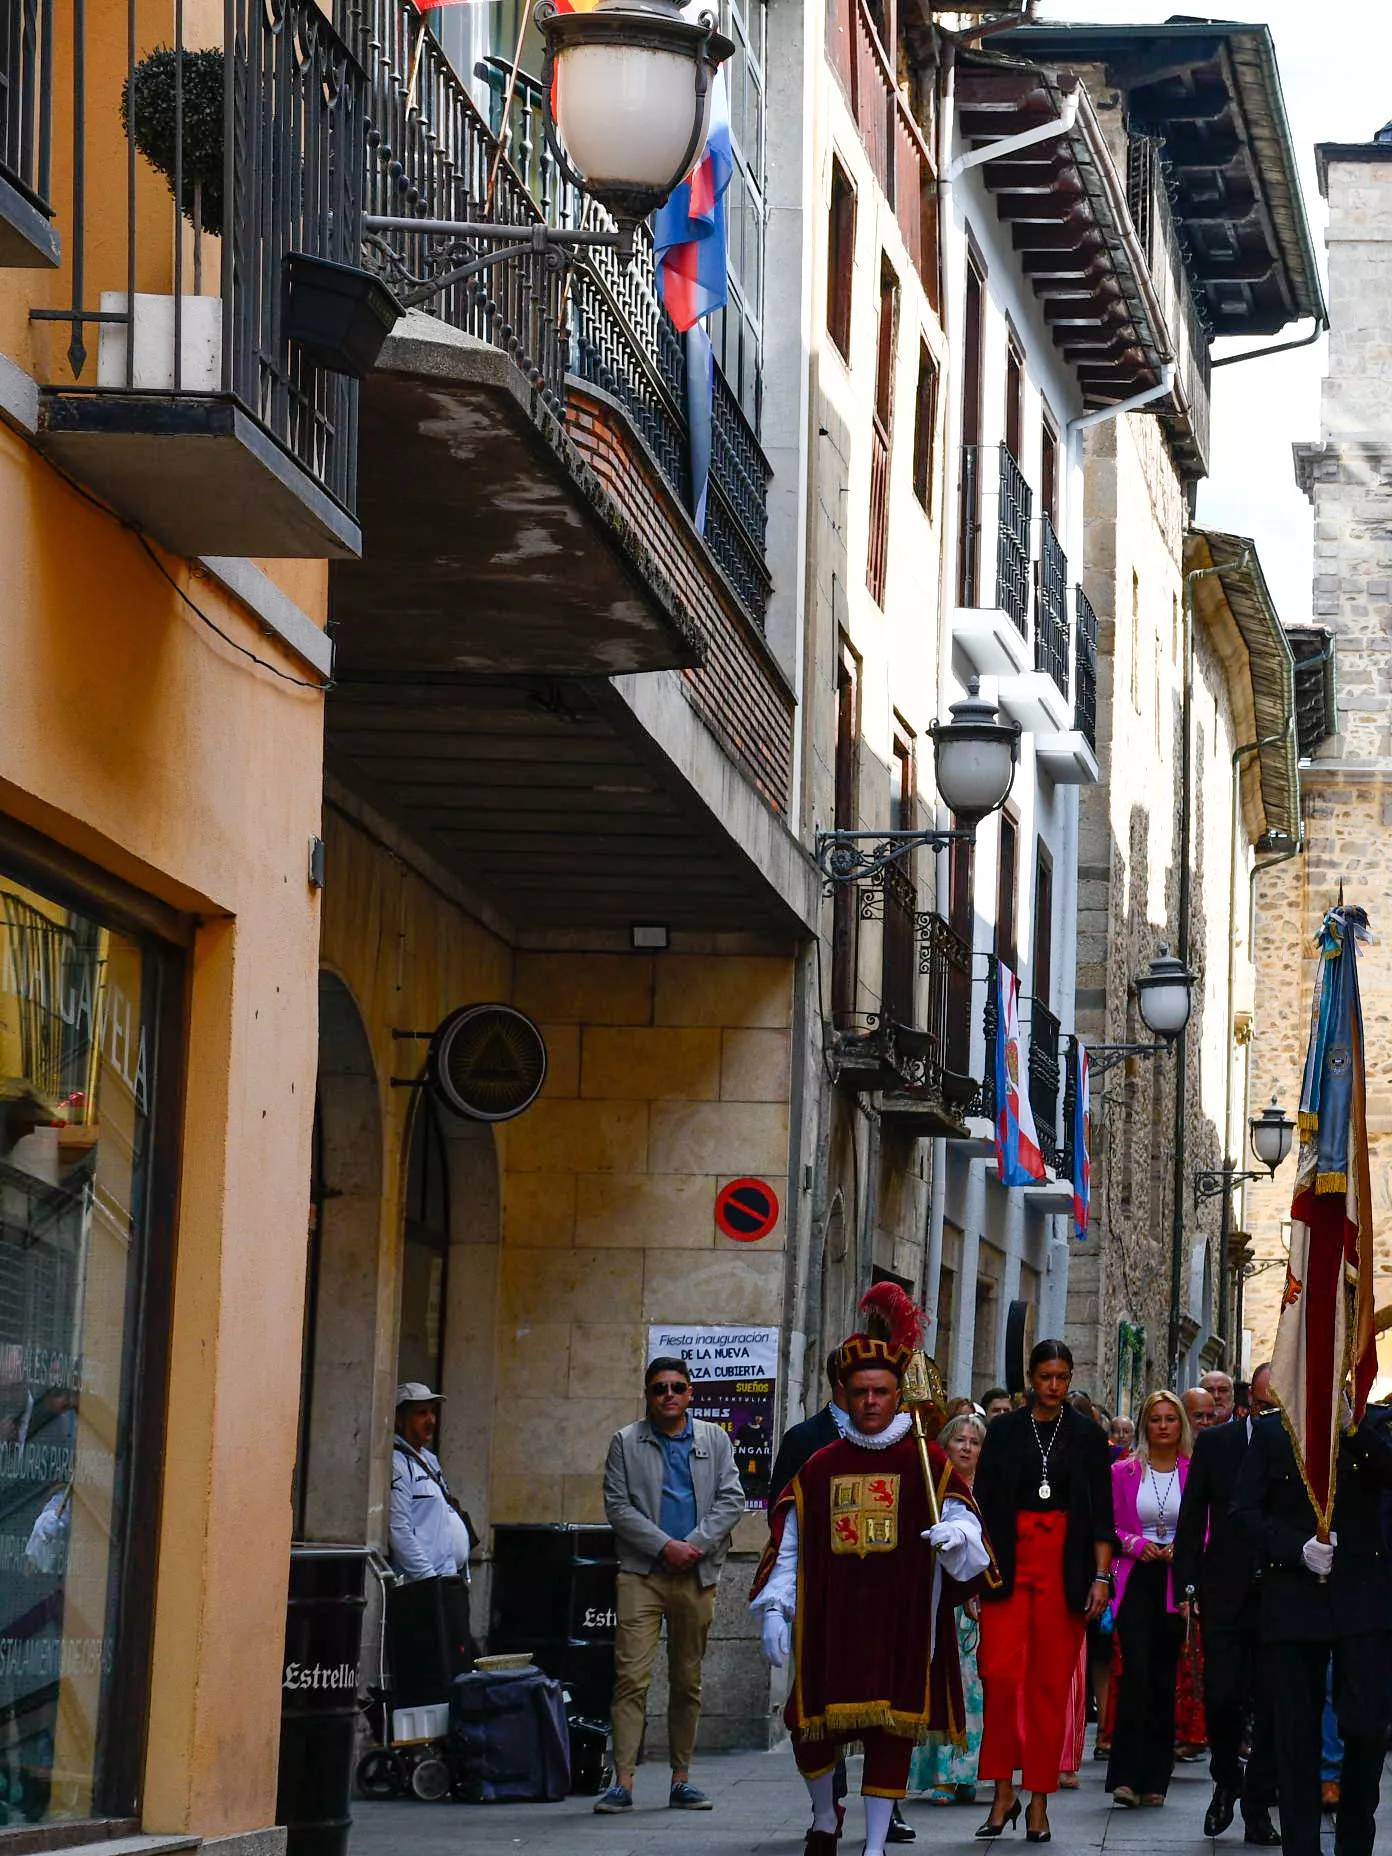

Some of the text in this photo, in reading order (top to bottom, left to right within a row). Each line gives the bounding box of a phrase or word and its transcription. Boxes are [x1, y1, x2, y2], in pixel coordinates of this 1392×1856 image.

[659, 1332, 770, 1346] Fiesta inauguración
[681, 1347, 750, 1360] DE LA NUEVA
[688, 1365, 765, 1378] AZA CUBIERTA
[687, 1408, 730, 1417] ERNES
[282, 1662, 355, 1689] Estrella
